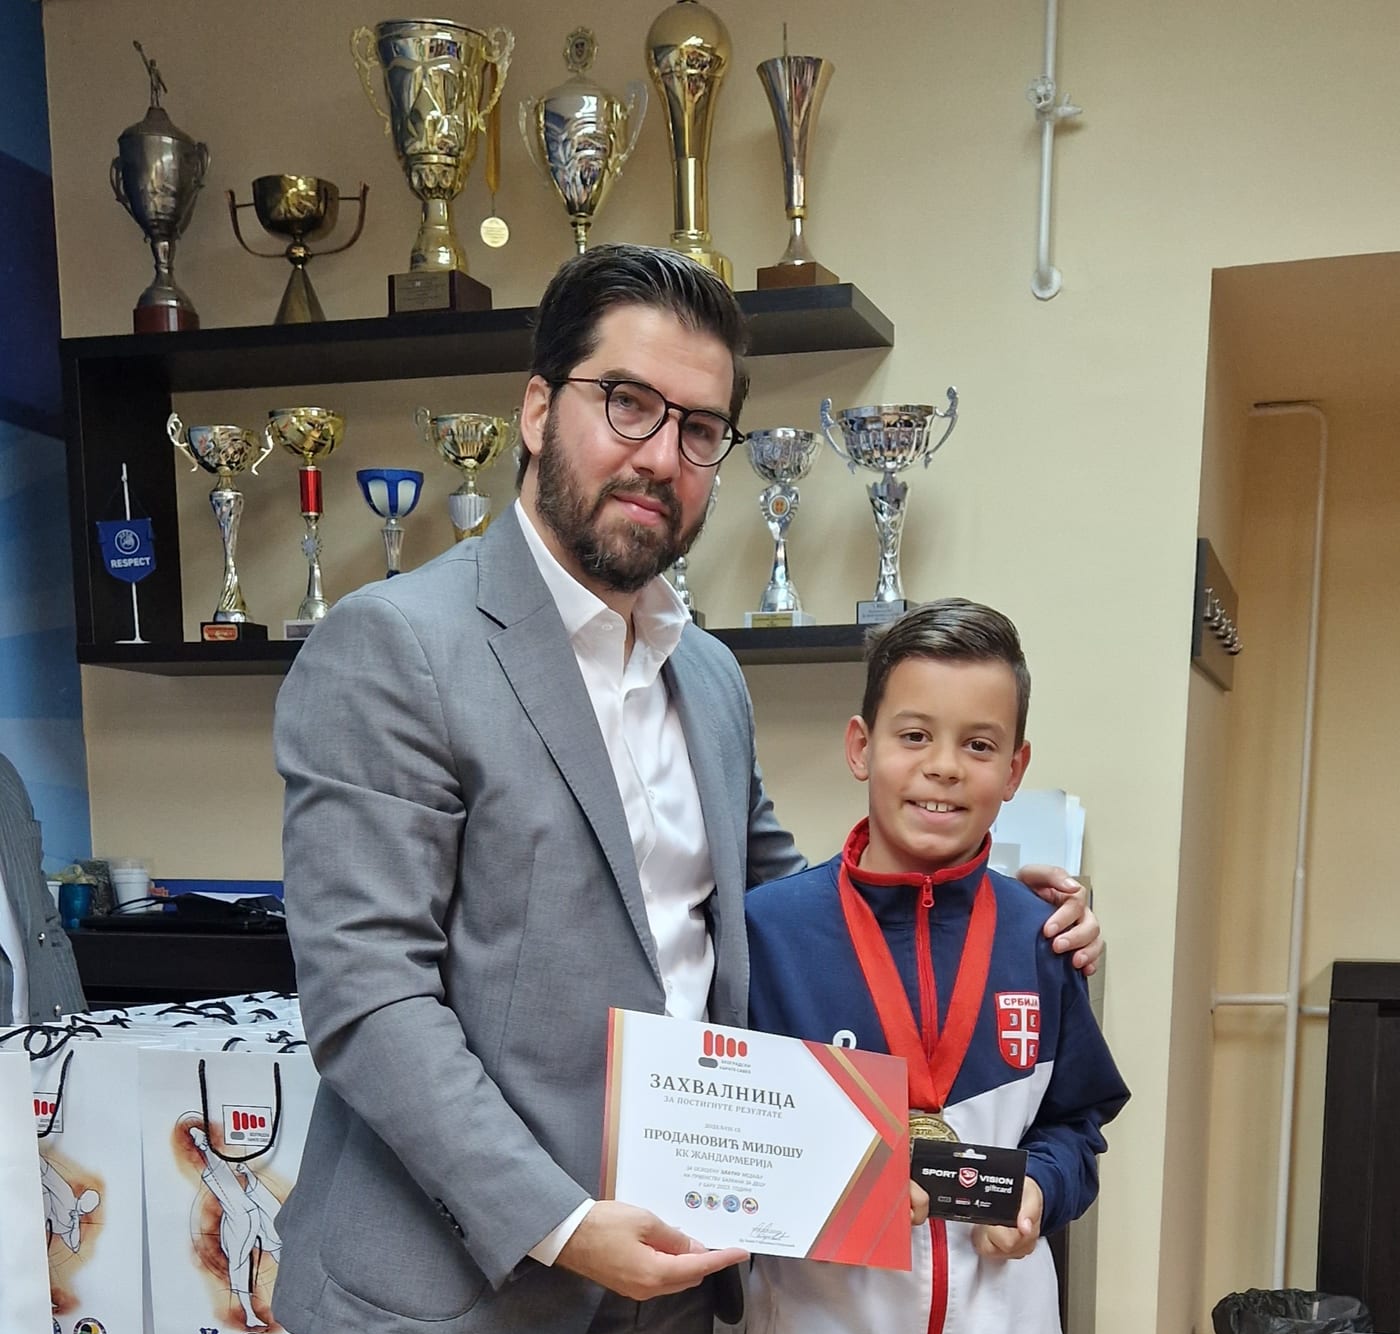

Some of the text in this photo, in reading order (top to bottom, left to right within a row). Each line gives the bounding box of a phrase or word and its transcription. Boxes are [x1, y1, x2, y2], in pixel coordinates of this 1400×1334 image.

[110, 556, 151, 569] RESPECT
[649, 1073, 796, 1110] ЗАХВАЛНИЦА
[663, 1095, 783, 1119] ЗА ПОСТИГНУТЕ РЕЗУЛТАТЕ
[643, 1128, 804, 1159] ПРОДАНОВИЋ МИЛОШУ
[675, 1147, 773, 1169] КК ЖАНДАРМЕРИЈА
[921, 1167, 1014, 1186] SPORT VISION
